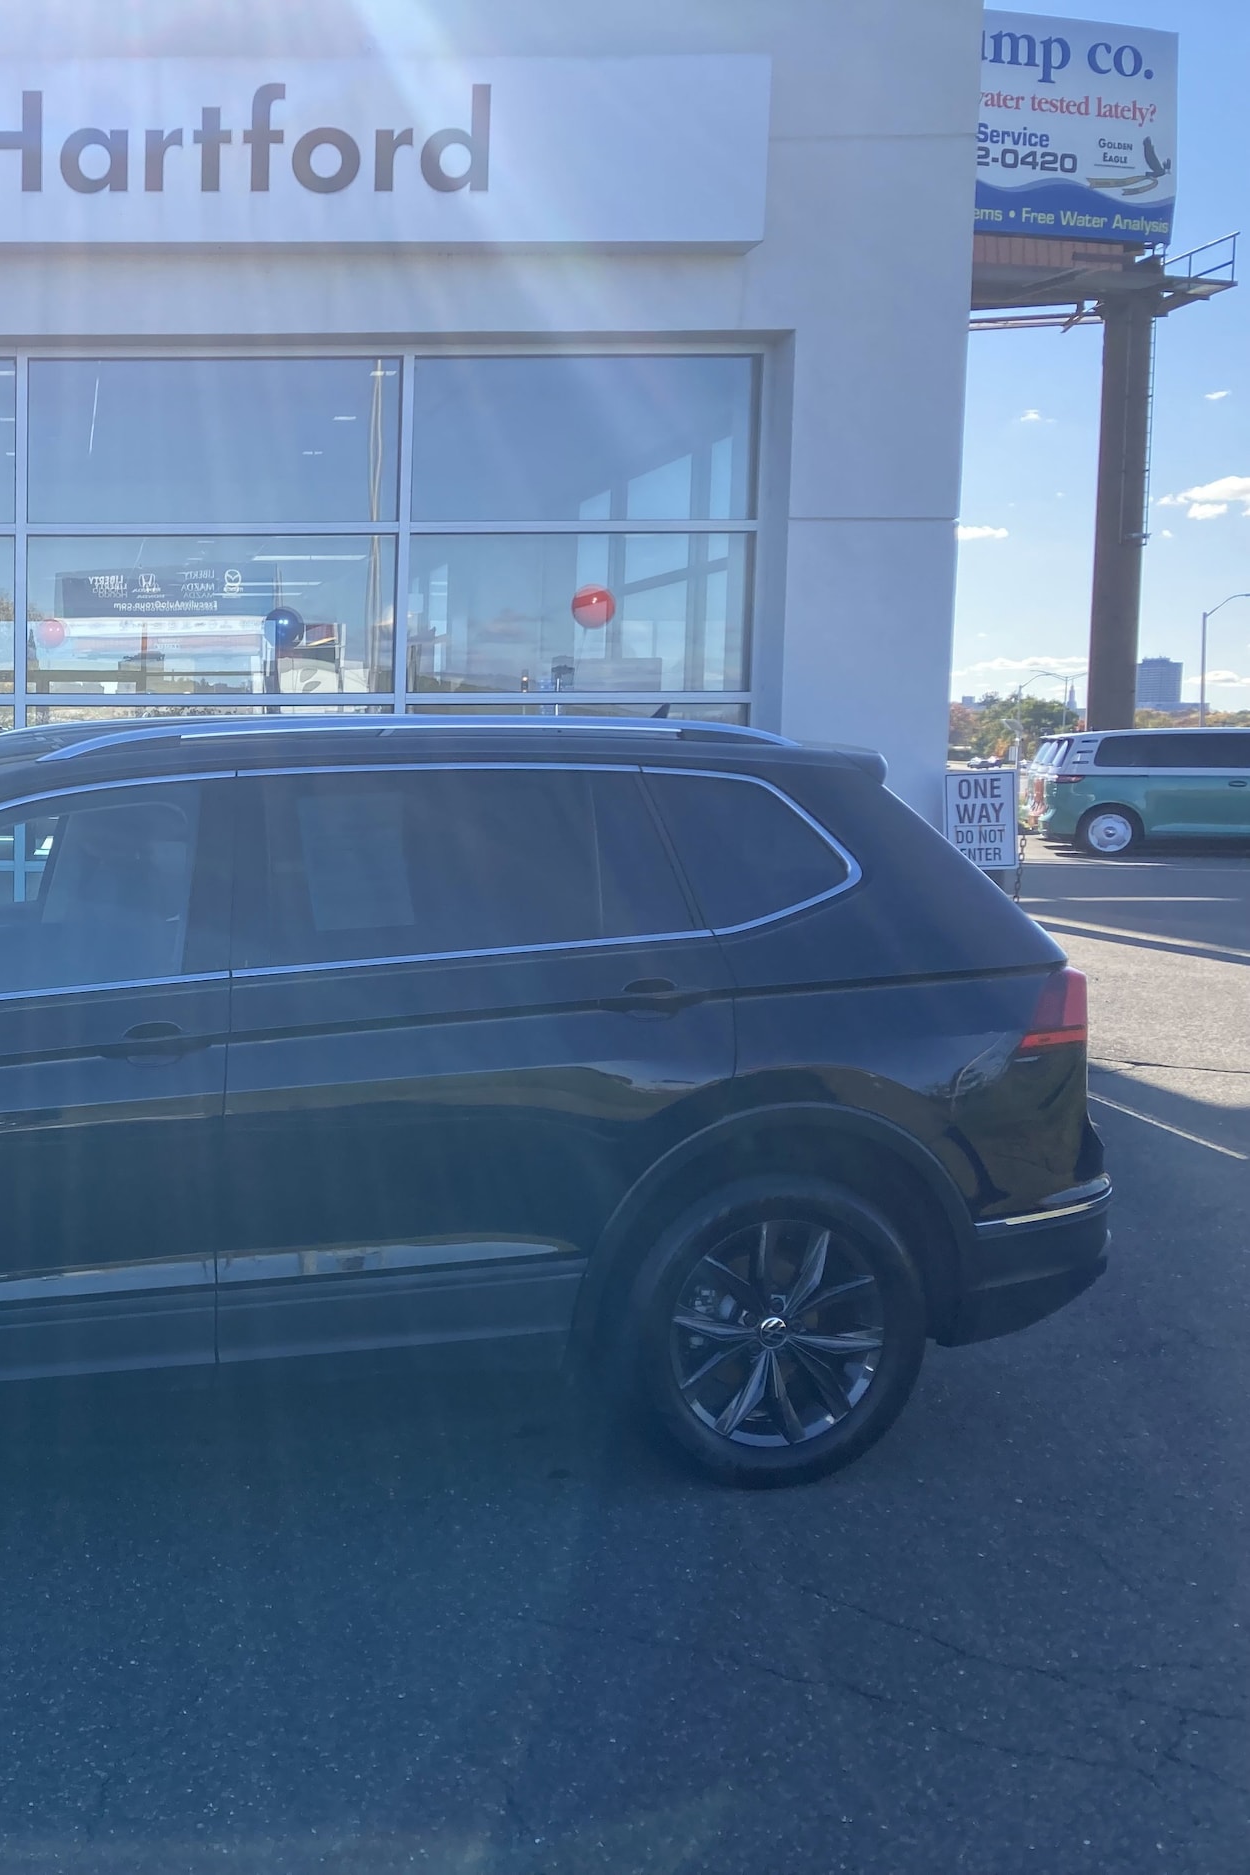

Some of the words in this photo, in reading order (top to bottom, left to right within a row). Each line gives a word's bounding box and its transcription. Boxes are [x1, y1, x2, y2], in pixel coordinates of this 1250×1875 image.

[1087, 42, 1154, 80] co.
[1030, 94, 1090, 116] tested
[1095, 97, 1157, 127] lately?
[976, 122, 1050, 148] Service
[977, 146, 1078, 174] 2-0420
[1021, 207, 1055, 225] Free
[1060, 211, 1108, 229] Water
[1112, 214, 1169, 236] Analysis
[958, 778, 1001, 800] ONE
[955, 802, 1004, 824] WAY
[956, 829, 974, 844] DO
[978, 828, 1005, 844] NOT
